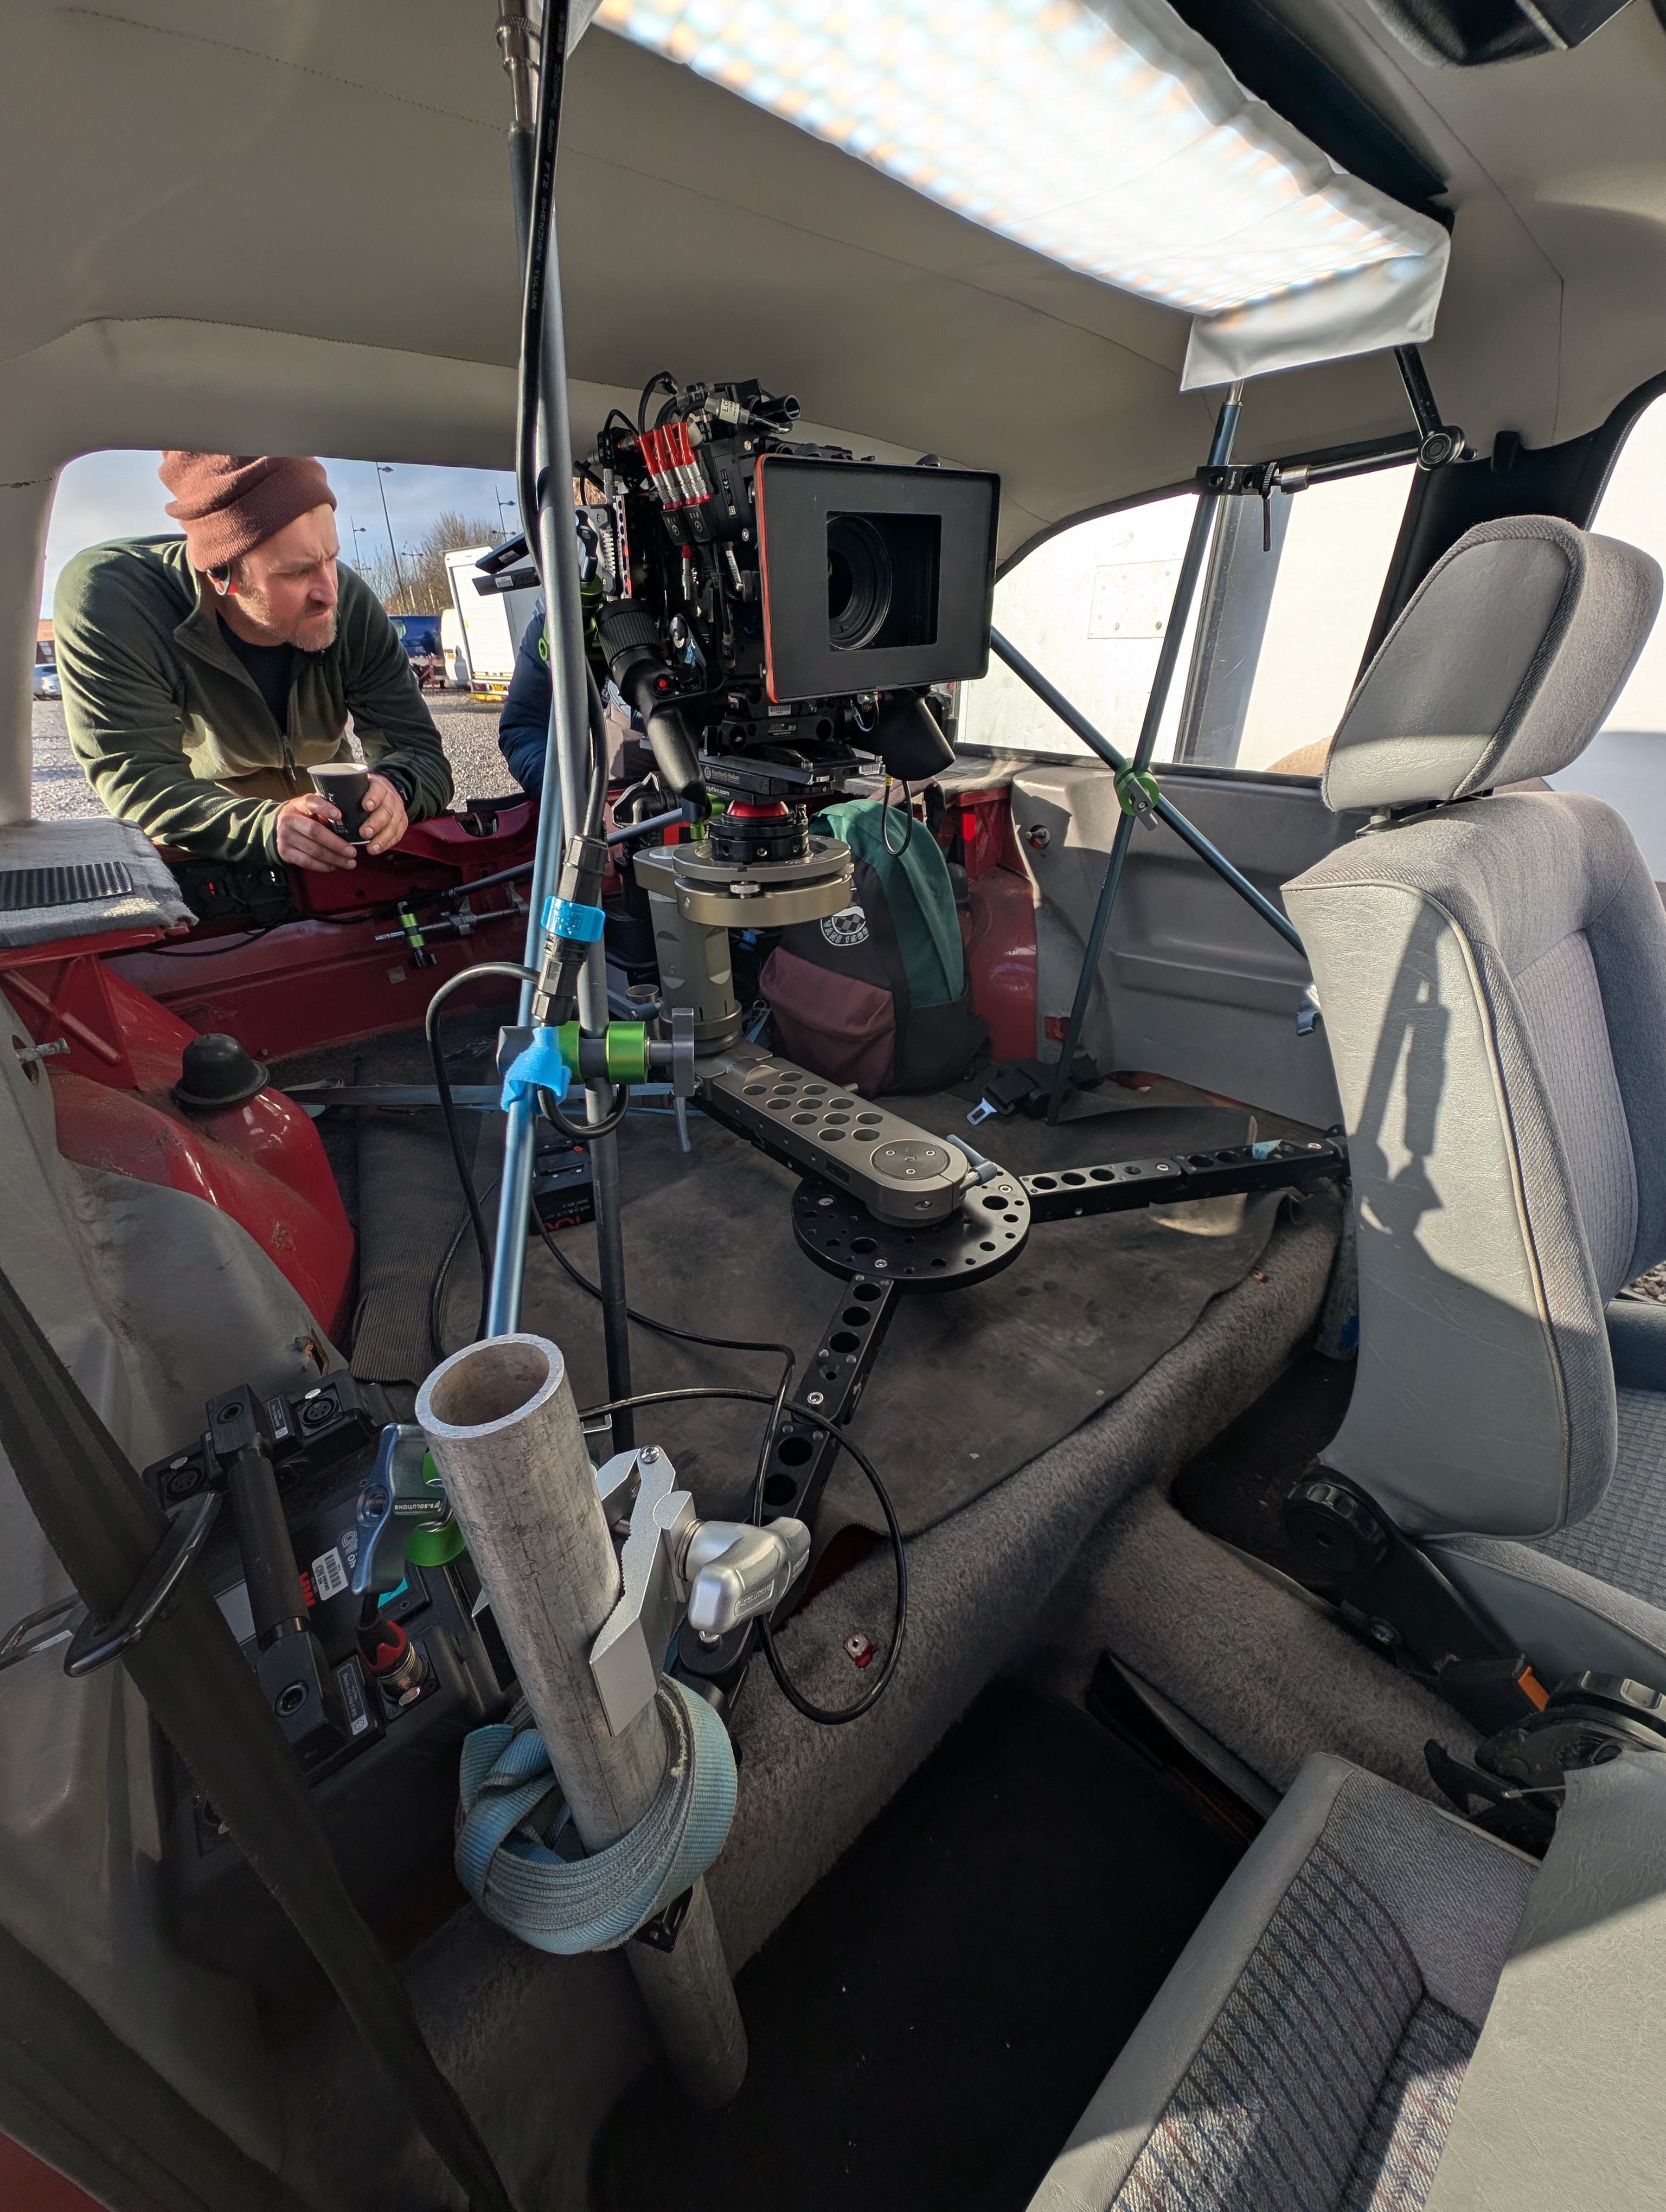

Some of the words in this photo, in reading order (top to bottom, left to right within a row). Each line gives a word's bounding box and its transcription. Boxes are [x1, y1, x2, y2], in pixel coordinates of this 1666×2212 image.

[535, 197, 547, 261] SHENZHEN
[531, 269, 543, 310] YULIAN
[706, 786, 729, 796] ripfilm.com
[823, 919, 842, 943] VANS
[845, 927, 869, 943] 1966
[317, 1577, 323, 1585] NO
[322, 1574, 330, 1591] DRAMA
